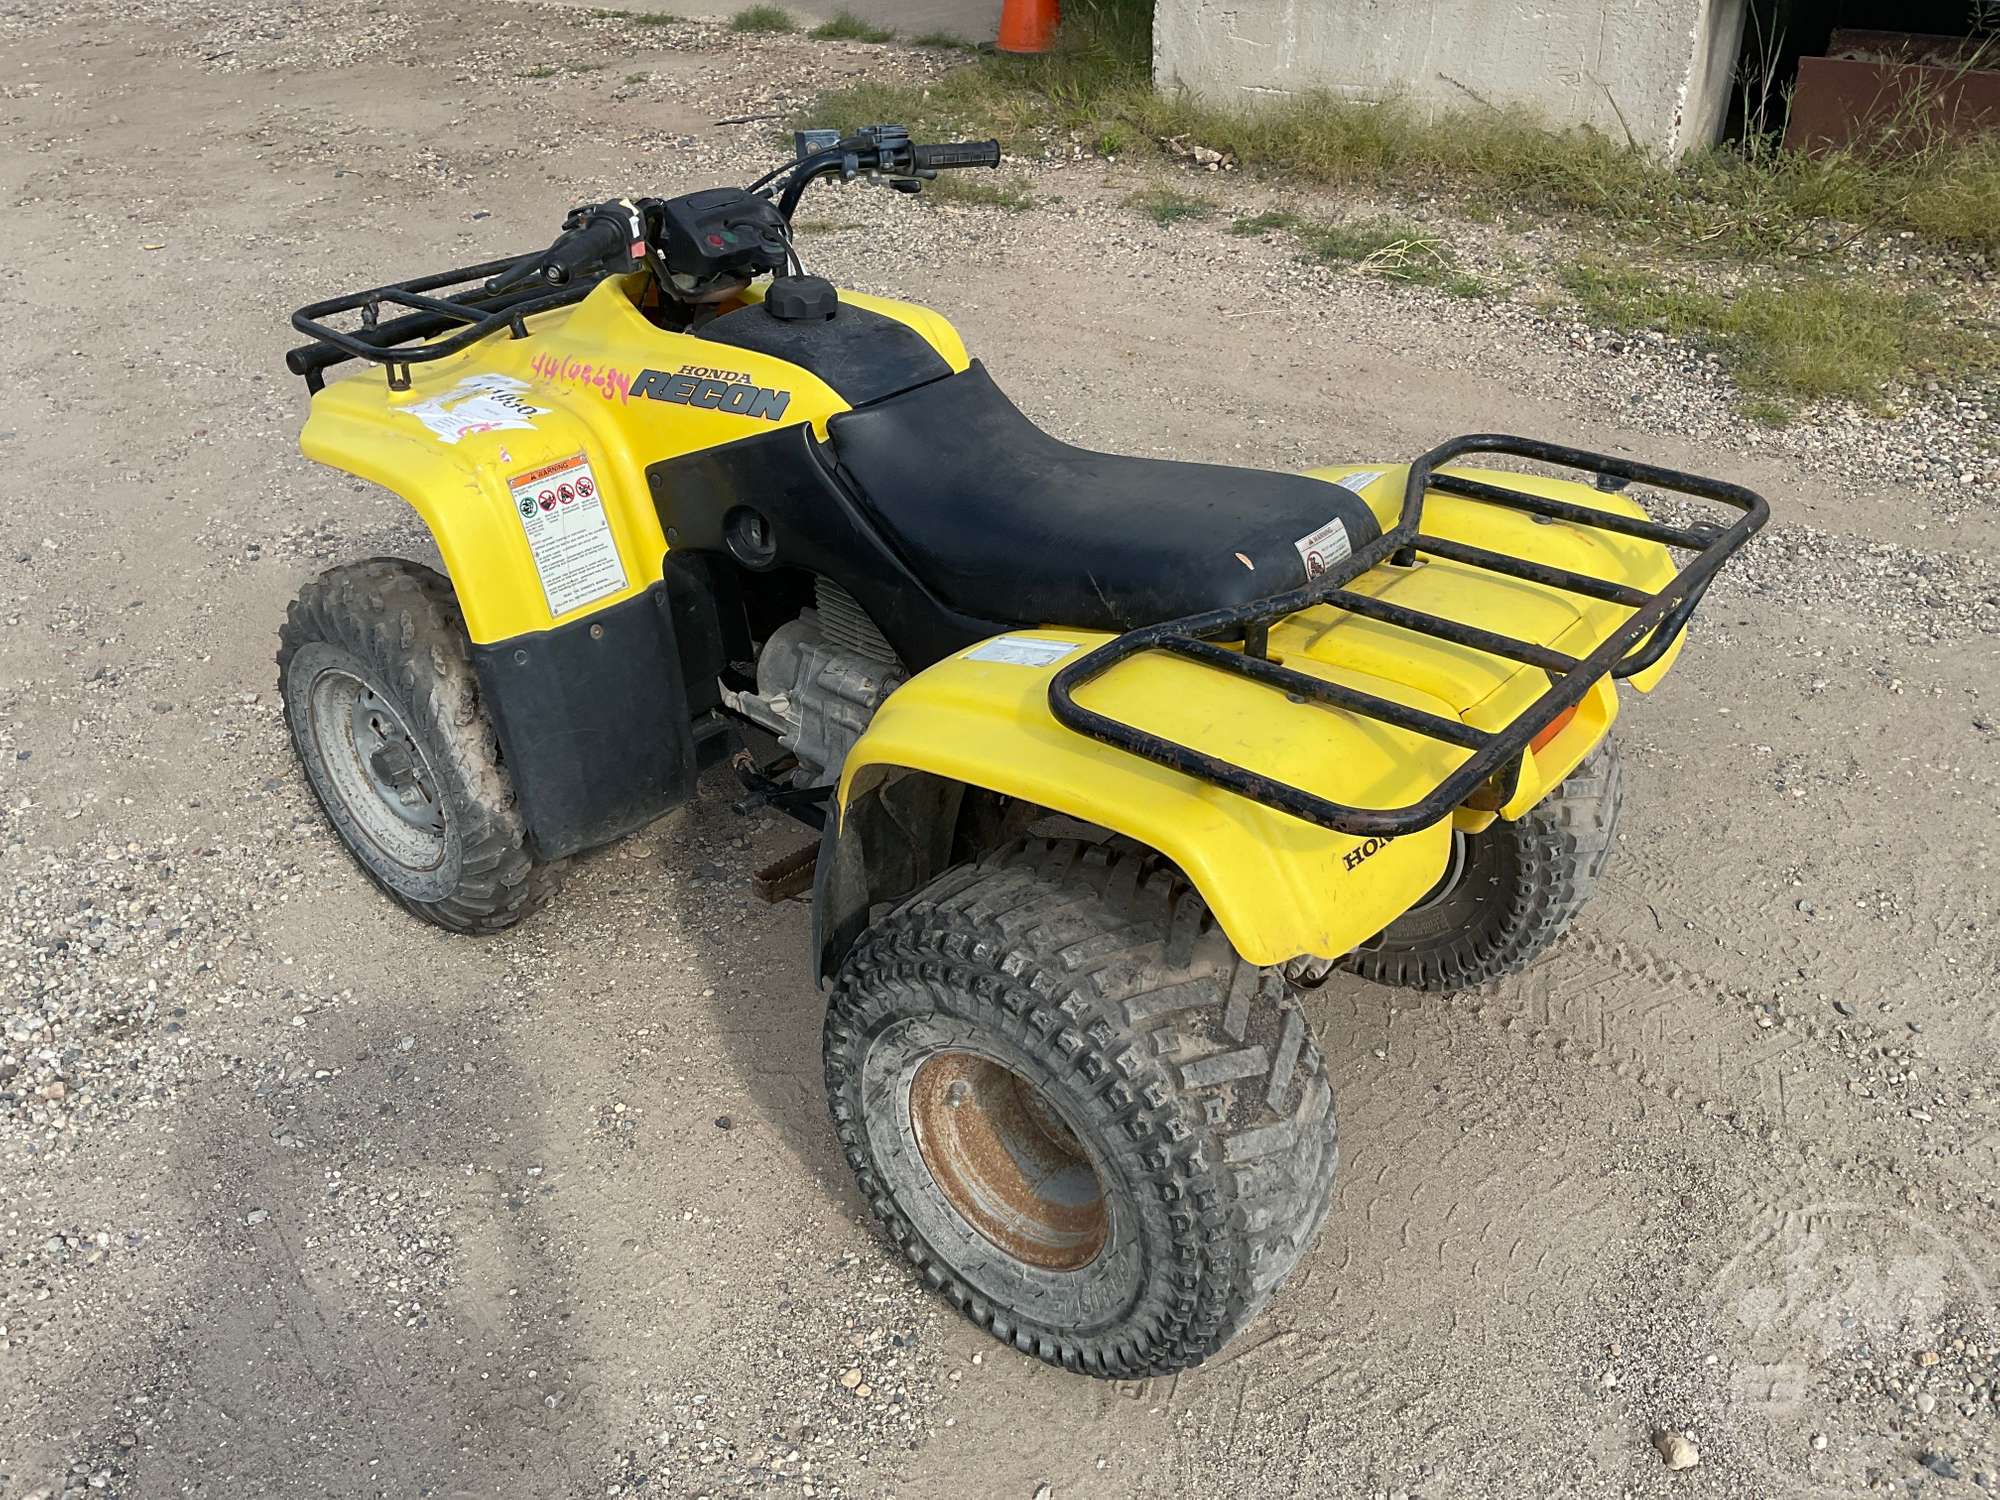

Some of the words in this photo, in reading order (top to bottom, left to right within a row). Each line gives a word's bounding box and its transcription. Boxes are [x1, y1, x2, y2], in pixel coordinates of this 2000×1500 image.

[677, 364, 752, 384] HONDA
[628, 368, 791, 421] RECON
[1343, 836, 1395, 872] HON
